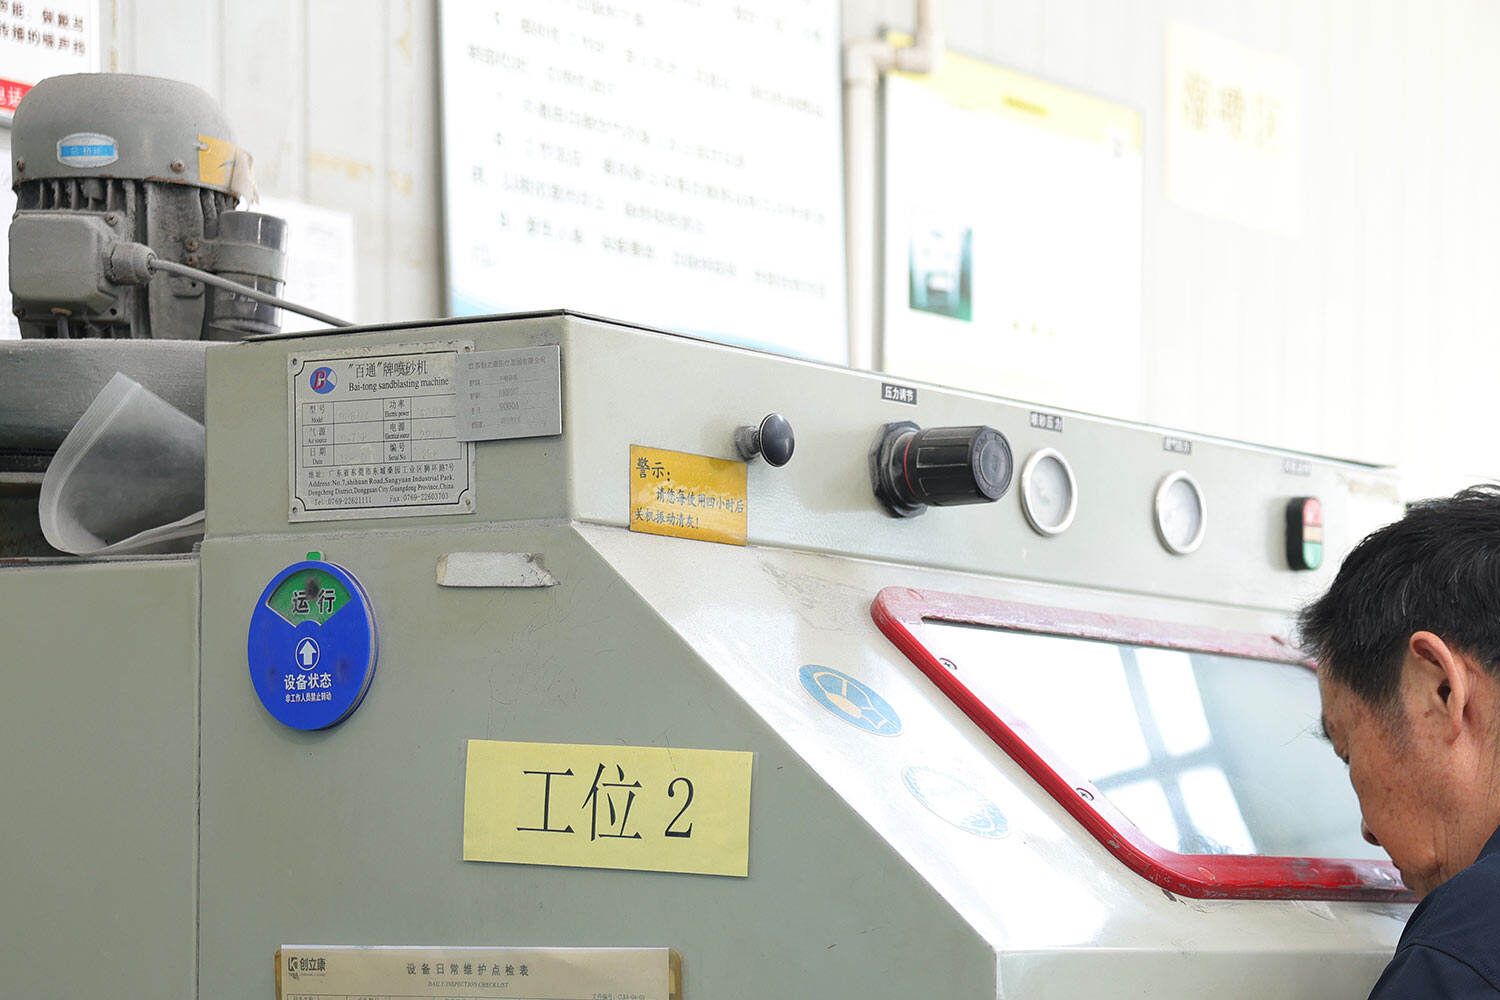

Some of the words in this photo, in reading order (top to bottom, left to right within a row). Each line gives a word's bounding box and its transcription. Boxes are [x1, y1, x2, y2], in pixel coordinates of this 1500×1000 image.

[348, 382, 377, 393] Bai-tong
[378, 379, 419, 391] sandblasting
[420, 378, 449, 389] machine
[885, 385, 914, 403] 压力调节
[412, 474, 439, 483] Industrial
[636, 457, 671, 482] 警示：
[307, 488, 335, 497] Dongcheng
[656, 486, 744, 513] 请您每使用四小时后
[293, 589, 335, 614] 运行
[284, 672, 332, 690] 设备状态
[515, 762, 642, 842] 工位
[664, 776, 694, 839] 2
[300, 956, 327, 972] 创立康
[406, 962, 529, 977] 设备日常维护点检表
